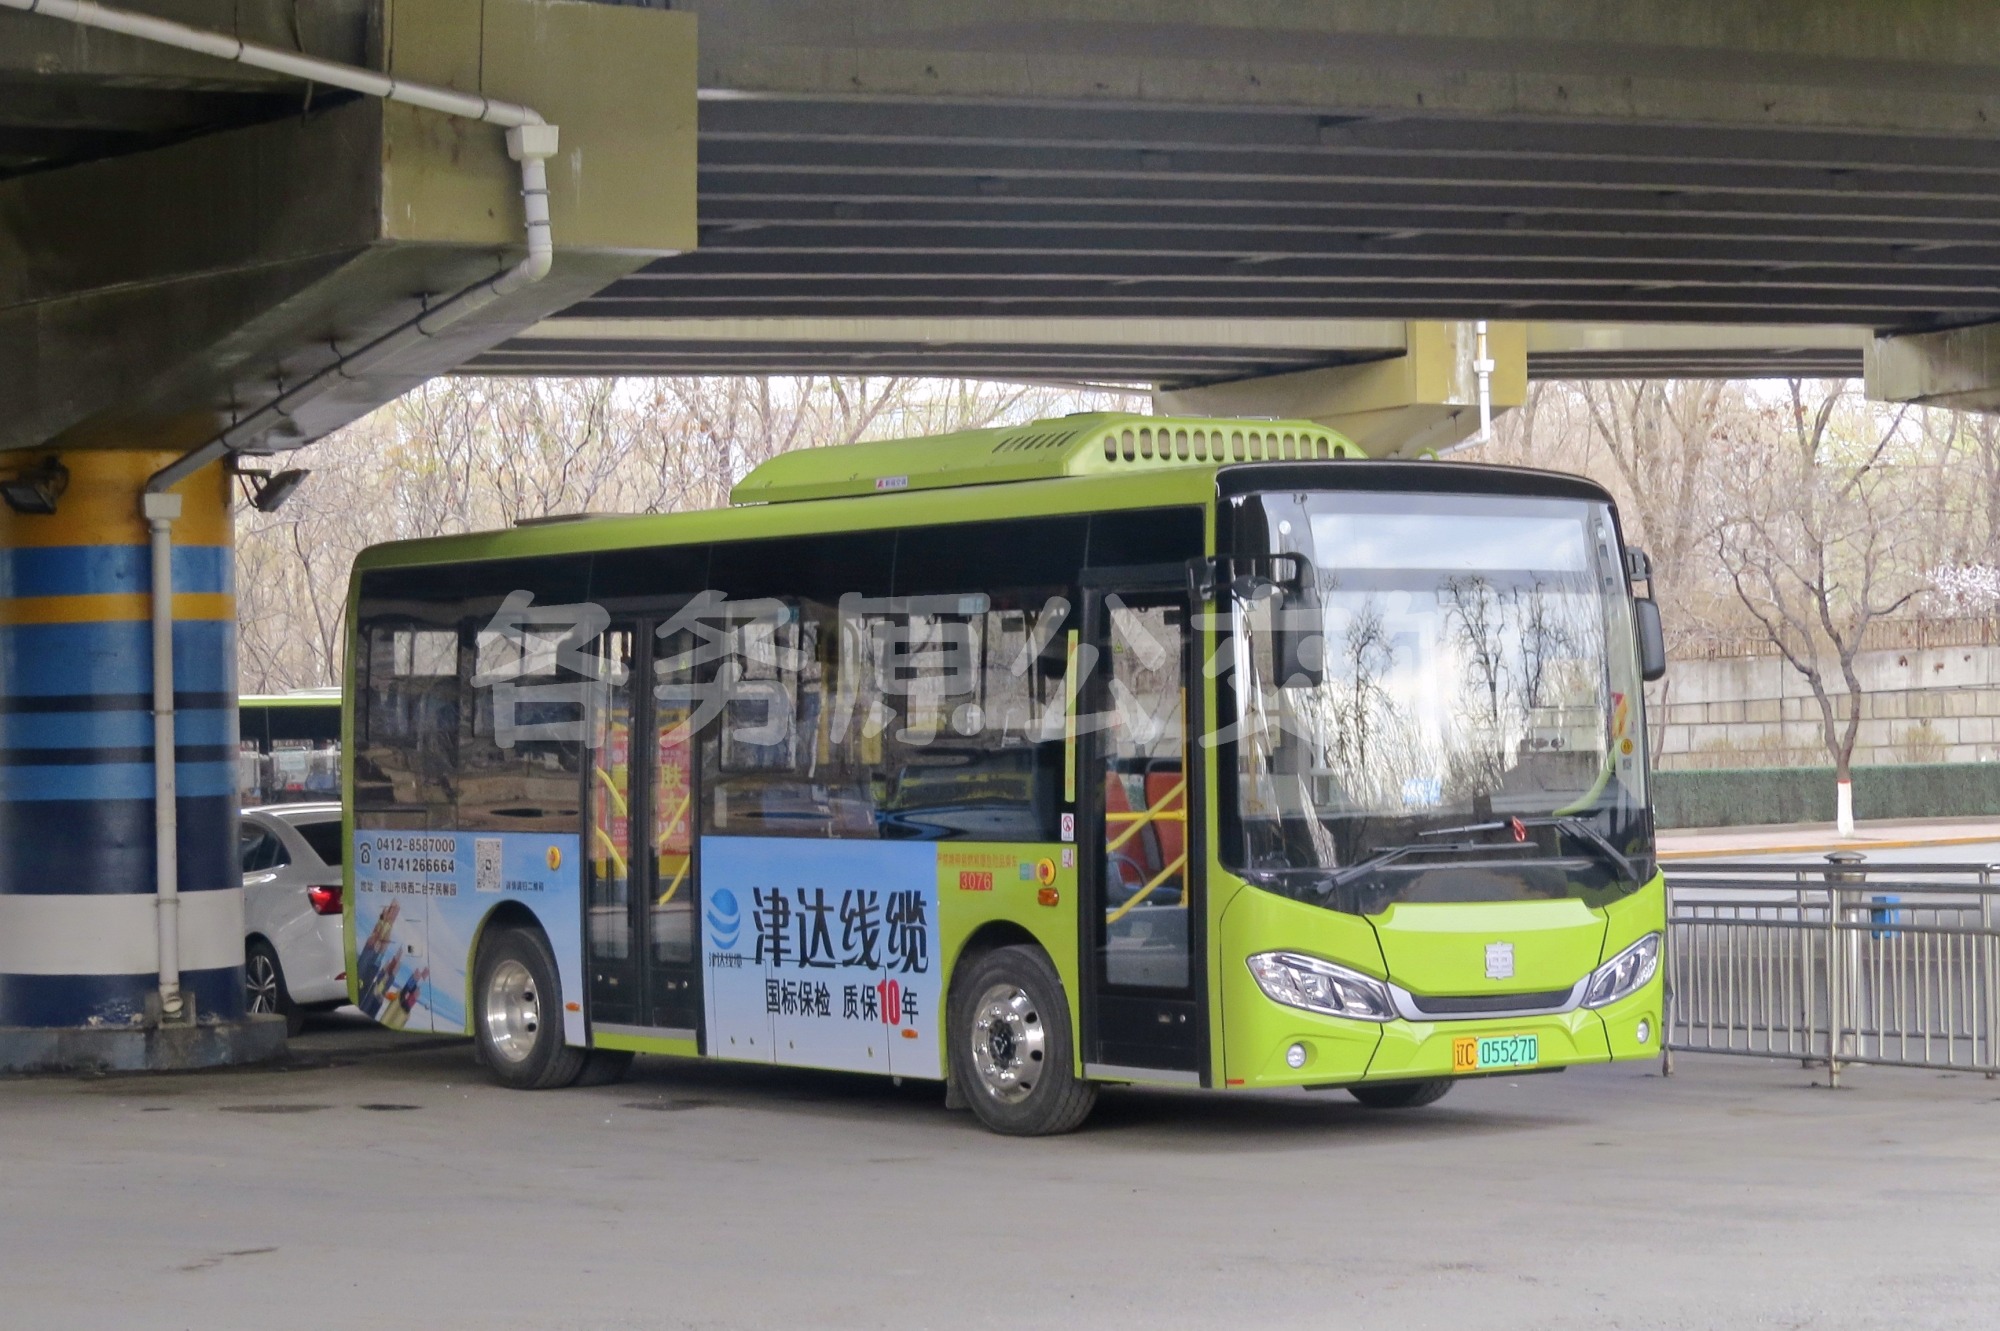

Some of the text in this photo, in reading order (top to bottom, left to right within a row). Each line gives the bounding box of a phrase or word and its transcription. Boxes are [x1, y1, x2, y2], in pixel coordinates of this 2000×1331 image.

[376, 837, 455, 853] 0412-8587000
[377, 857, 455, 873] 18741266664
[960, 872, 992, 889] 3076
[752, 886, 929, 974] 津达线缆
[765, 978, 919, 1026] 国标保检 质保10年
